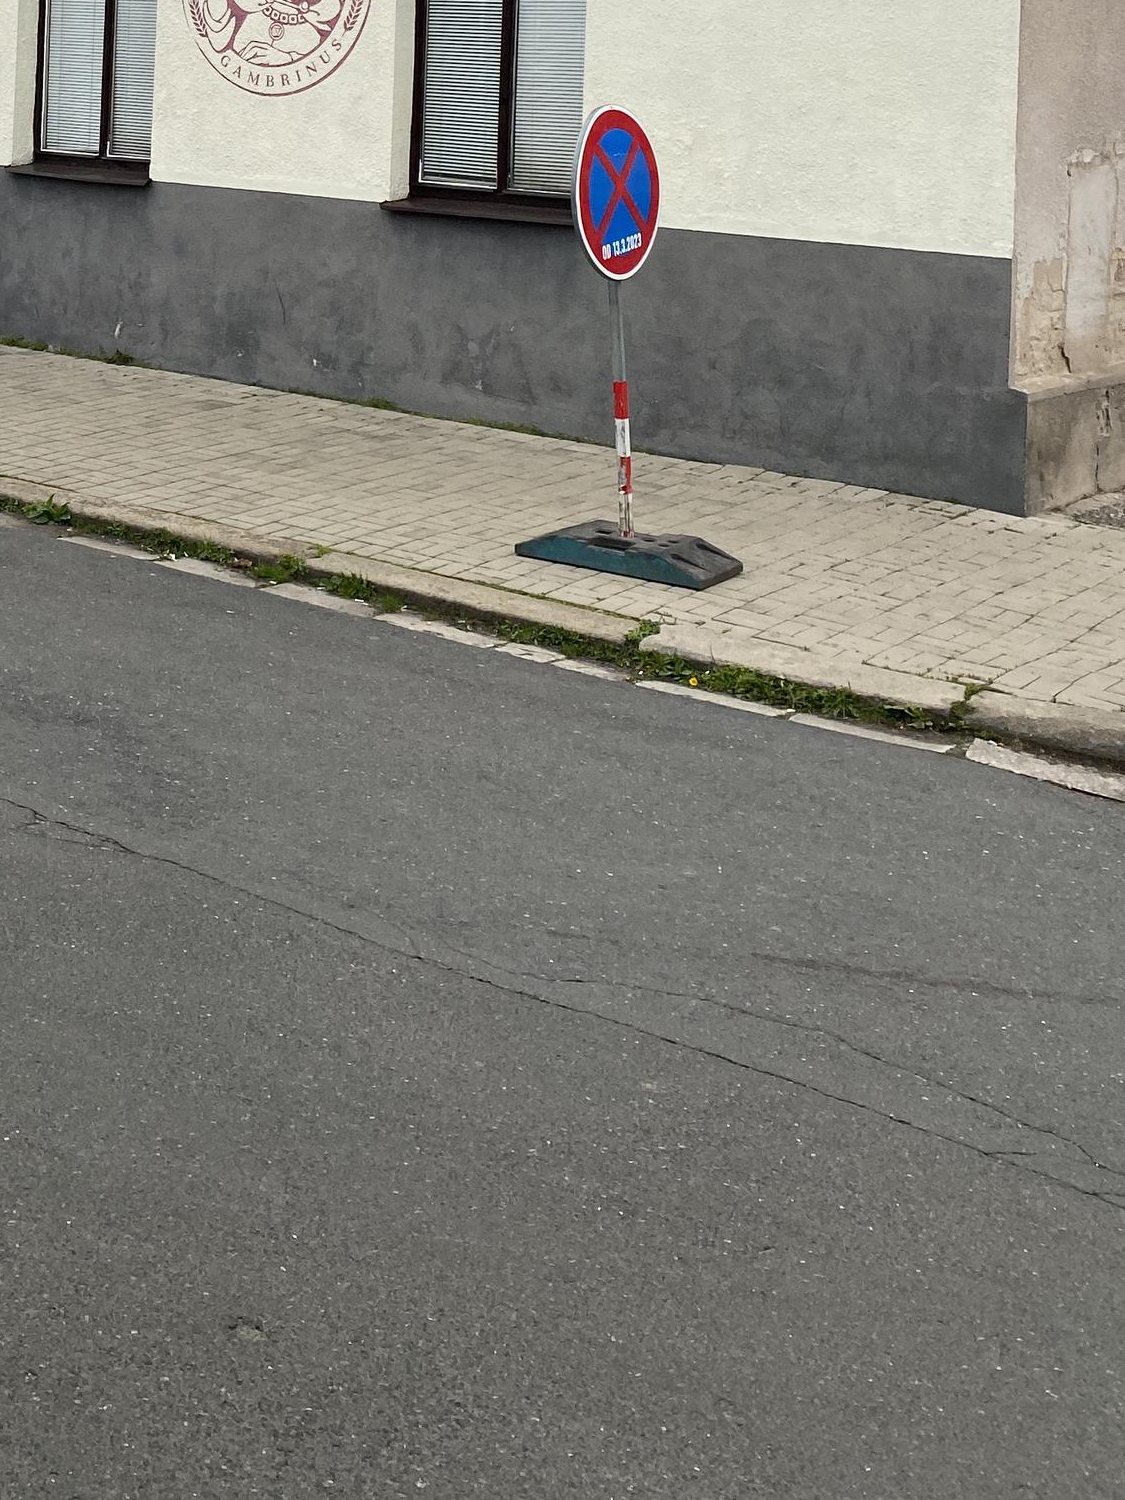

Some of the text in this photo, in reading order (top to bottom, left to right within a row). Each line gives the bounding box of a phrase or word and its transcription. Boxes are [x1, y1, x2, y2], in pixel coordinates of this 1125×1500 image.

[220, 38, 343, 88] GAMBRINUS
[602, 232, 642, 261] OD 13.3.2023
